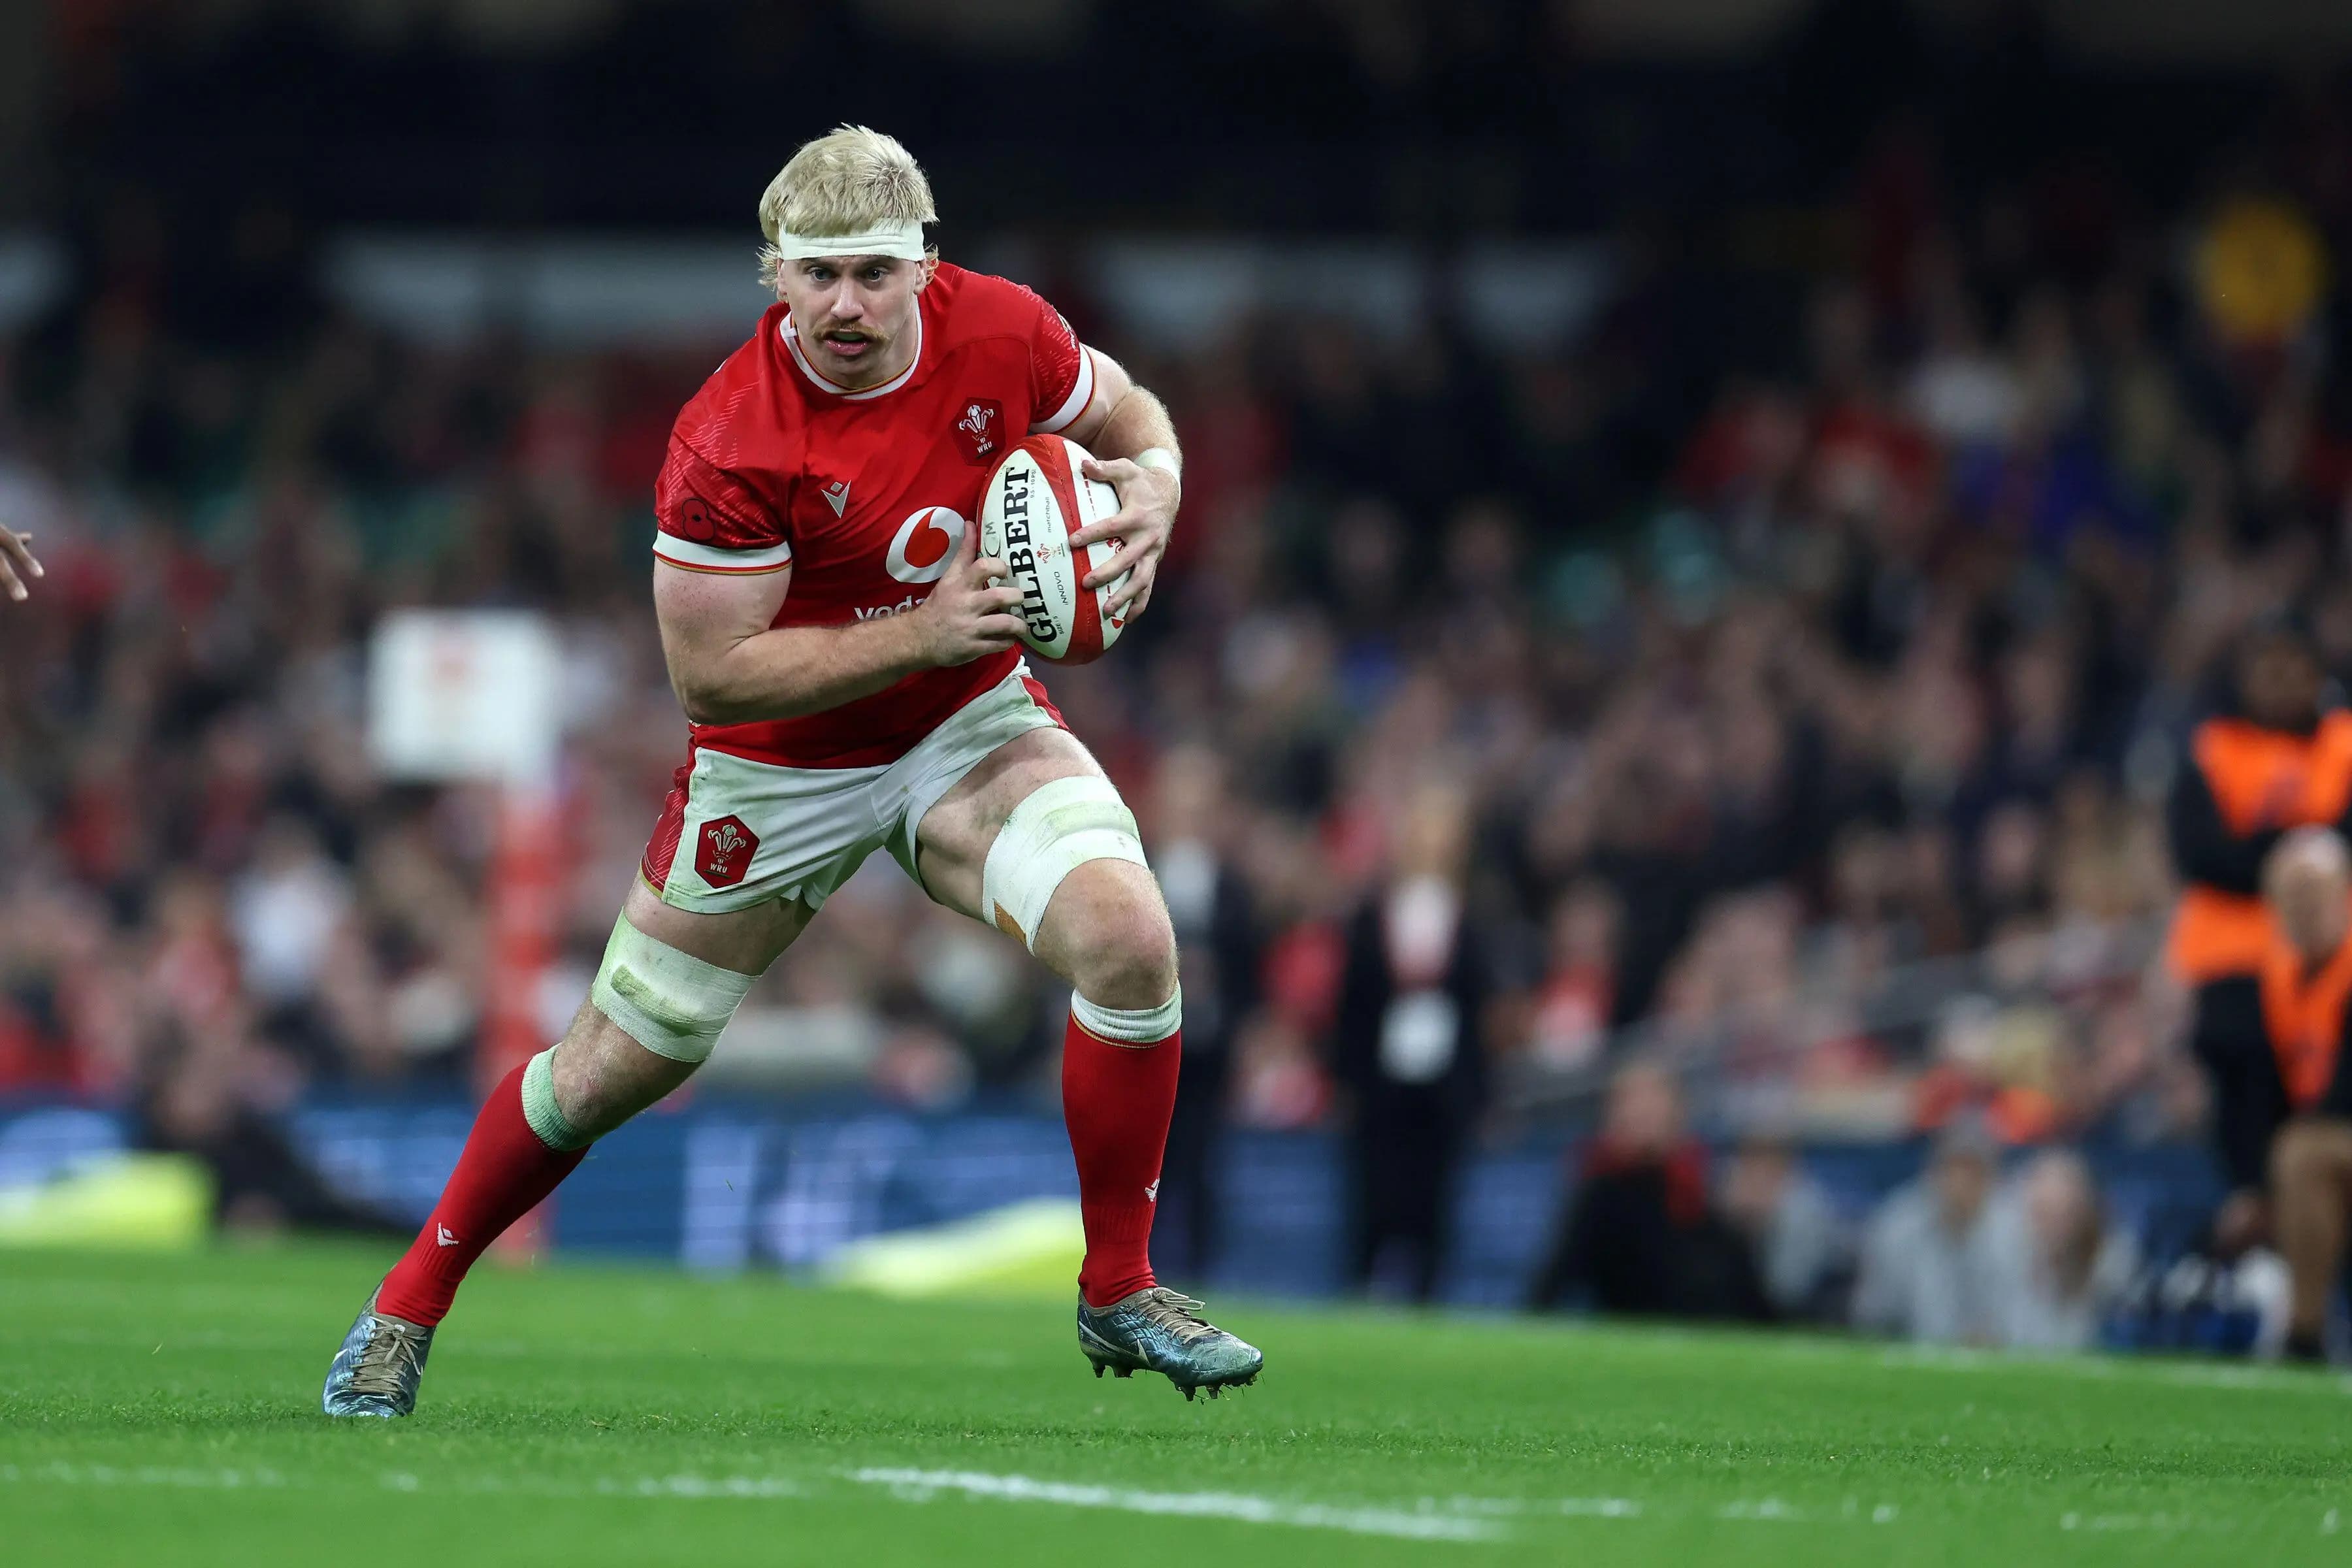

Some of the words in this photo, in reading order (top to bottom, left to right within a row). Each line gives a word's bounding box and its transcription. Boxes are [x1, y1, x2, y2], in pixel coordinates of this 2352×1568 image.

[977, 441, 992, 453] WRU
[1004, 467, 1057, 642] GILBERT
[854, 595, 925, 620] vod
[710, 862, 727, 874] WRU
